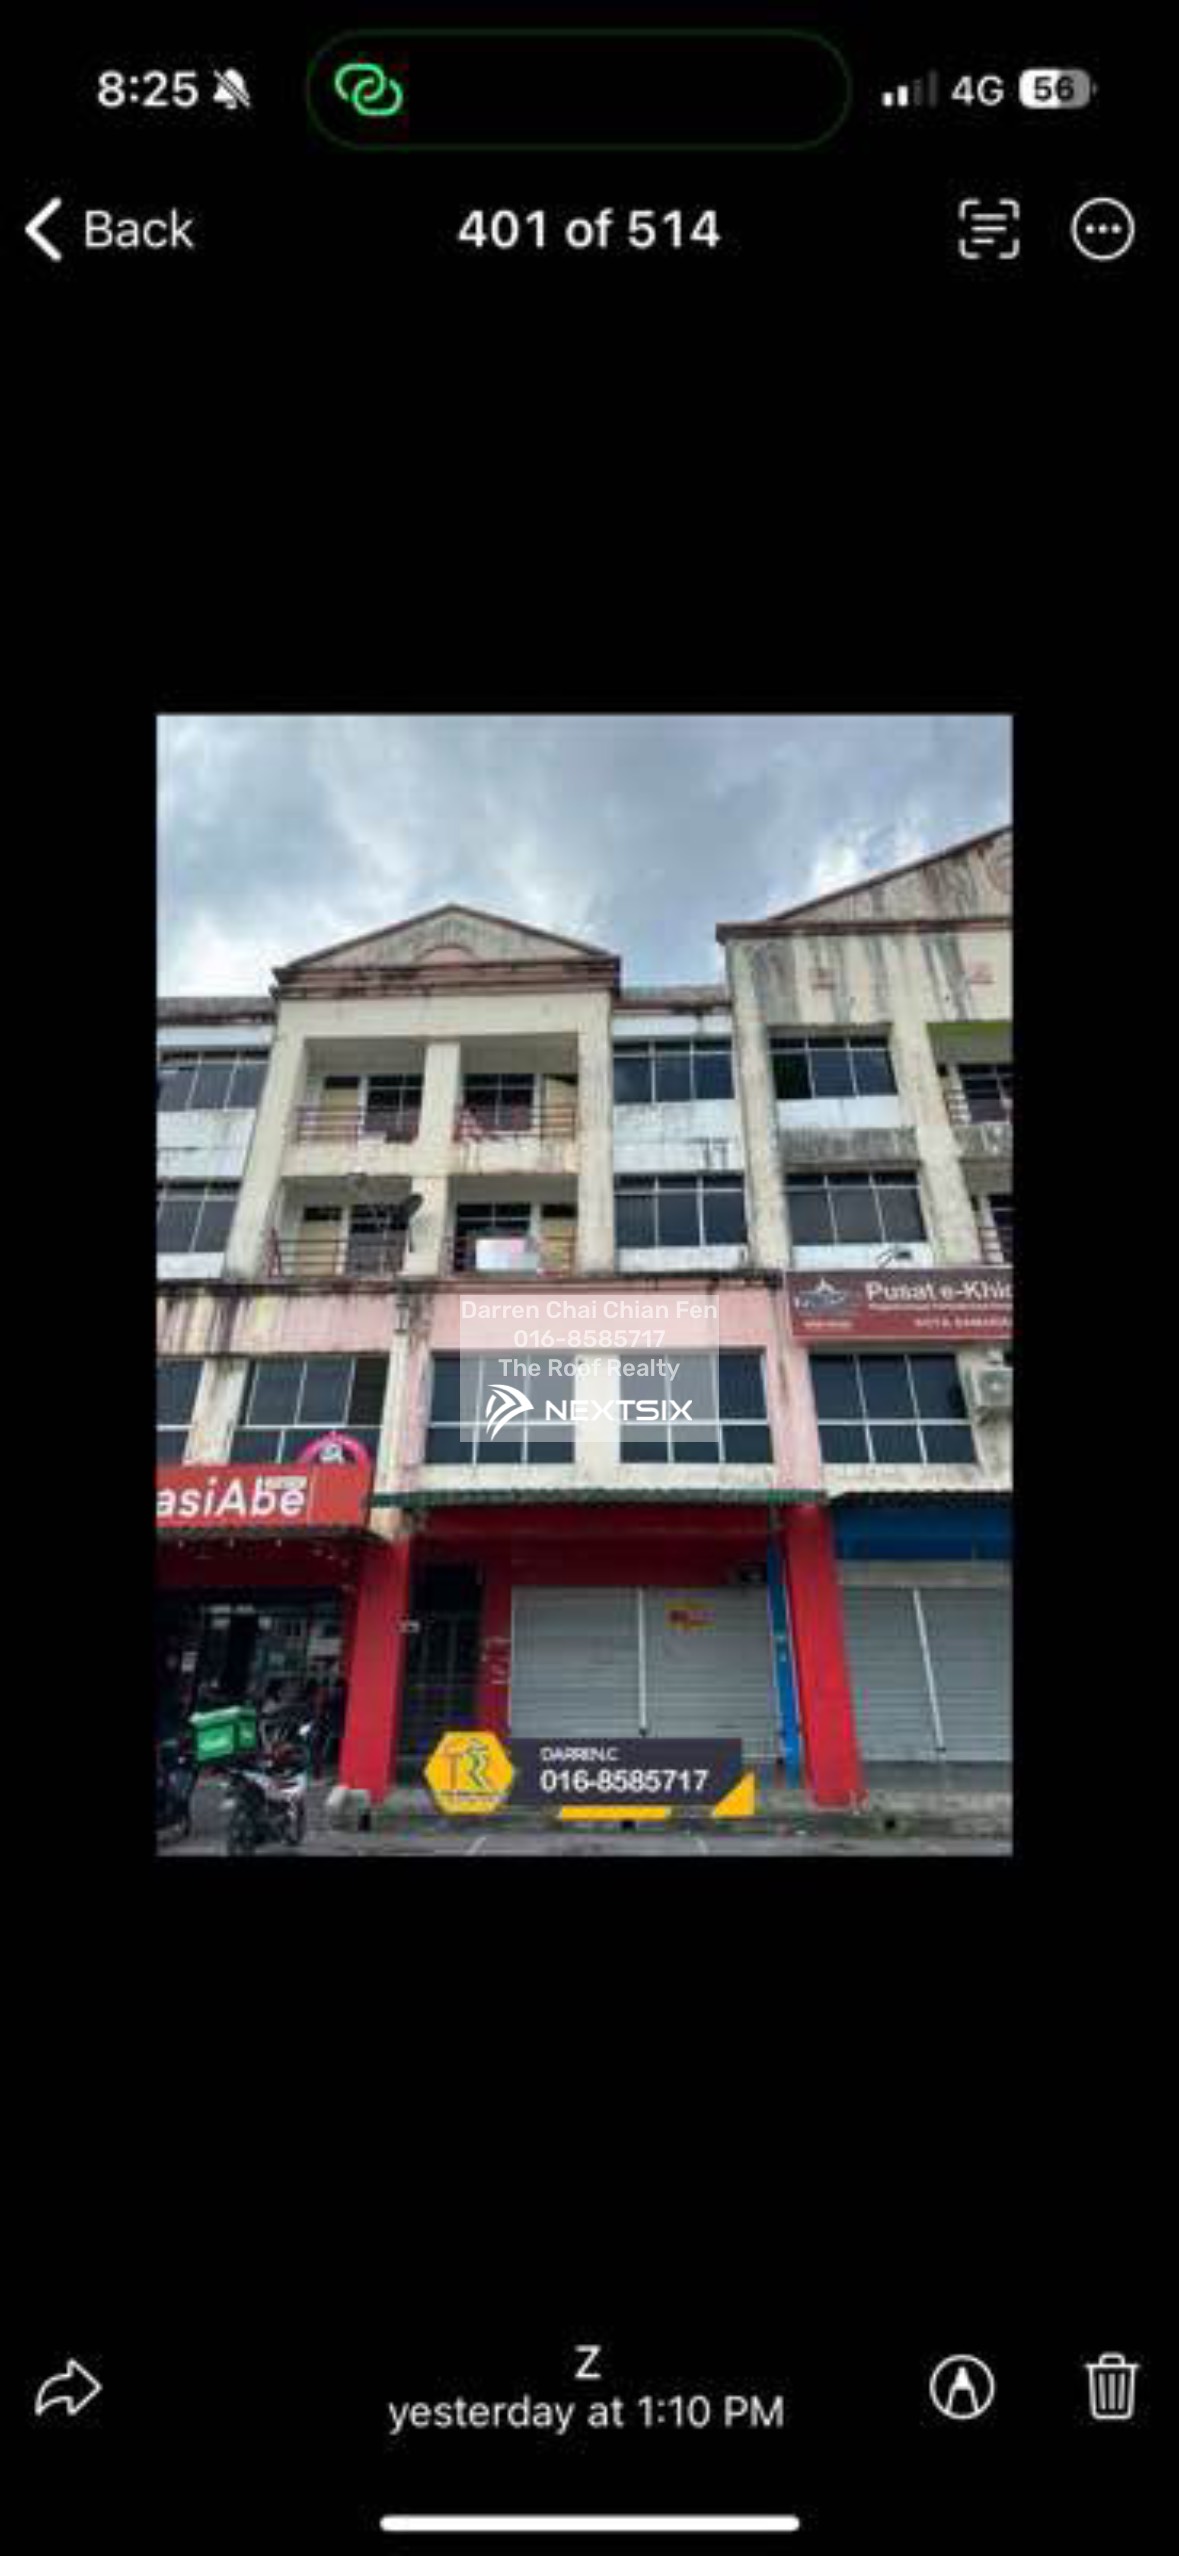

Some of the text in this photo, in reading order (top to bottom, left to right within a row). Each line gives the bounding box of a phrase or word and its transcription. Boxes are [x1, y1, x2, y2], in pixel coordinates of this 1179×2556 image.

[97, 70, 199, 108] 8:25
[951, 75, 1004, 107] 4G
[1034, 75, 1074, 102] 56
[85, 208, 194, 249] Back
[458, 207, 721, 249] 401 of 514
[864, 1280, 936, 1301] Pusat
[574, 2344, 601, 2379] Z
[388, 2395, 784, 2435] yesterday at 1:10 PM
